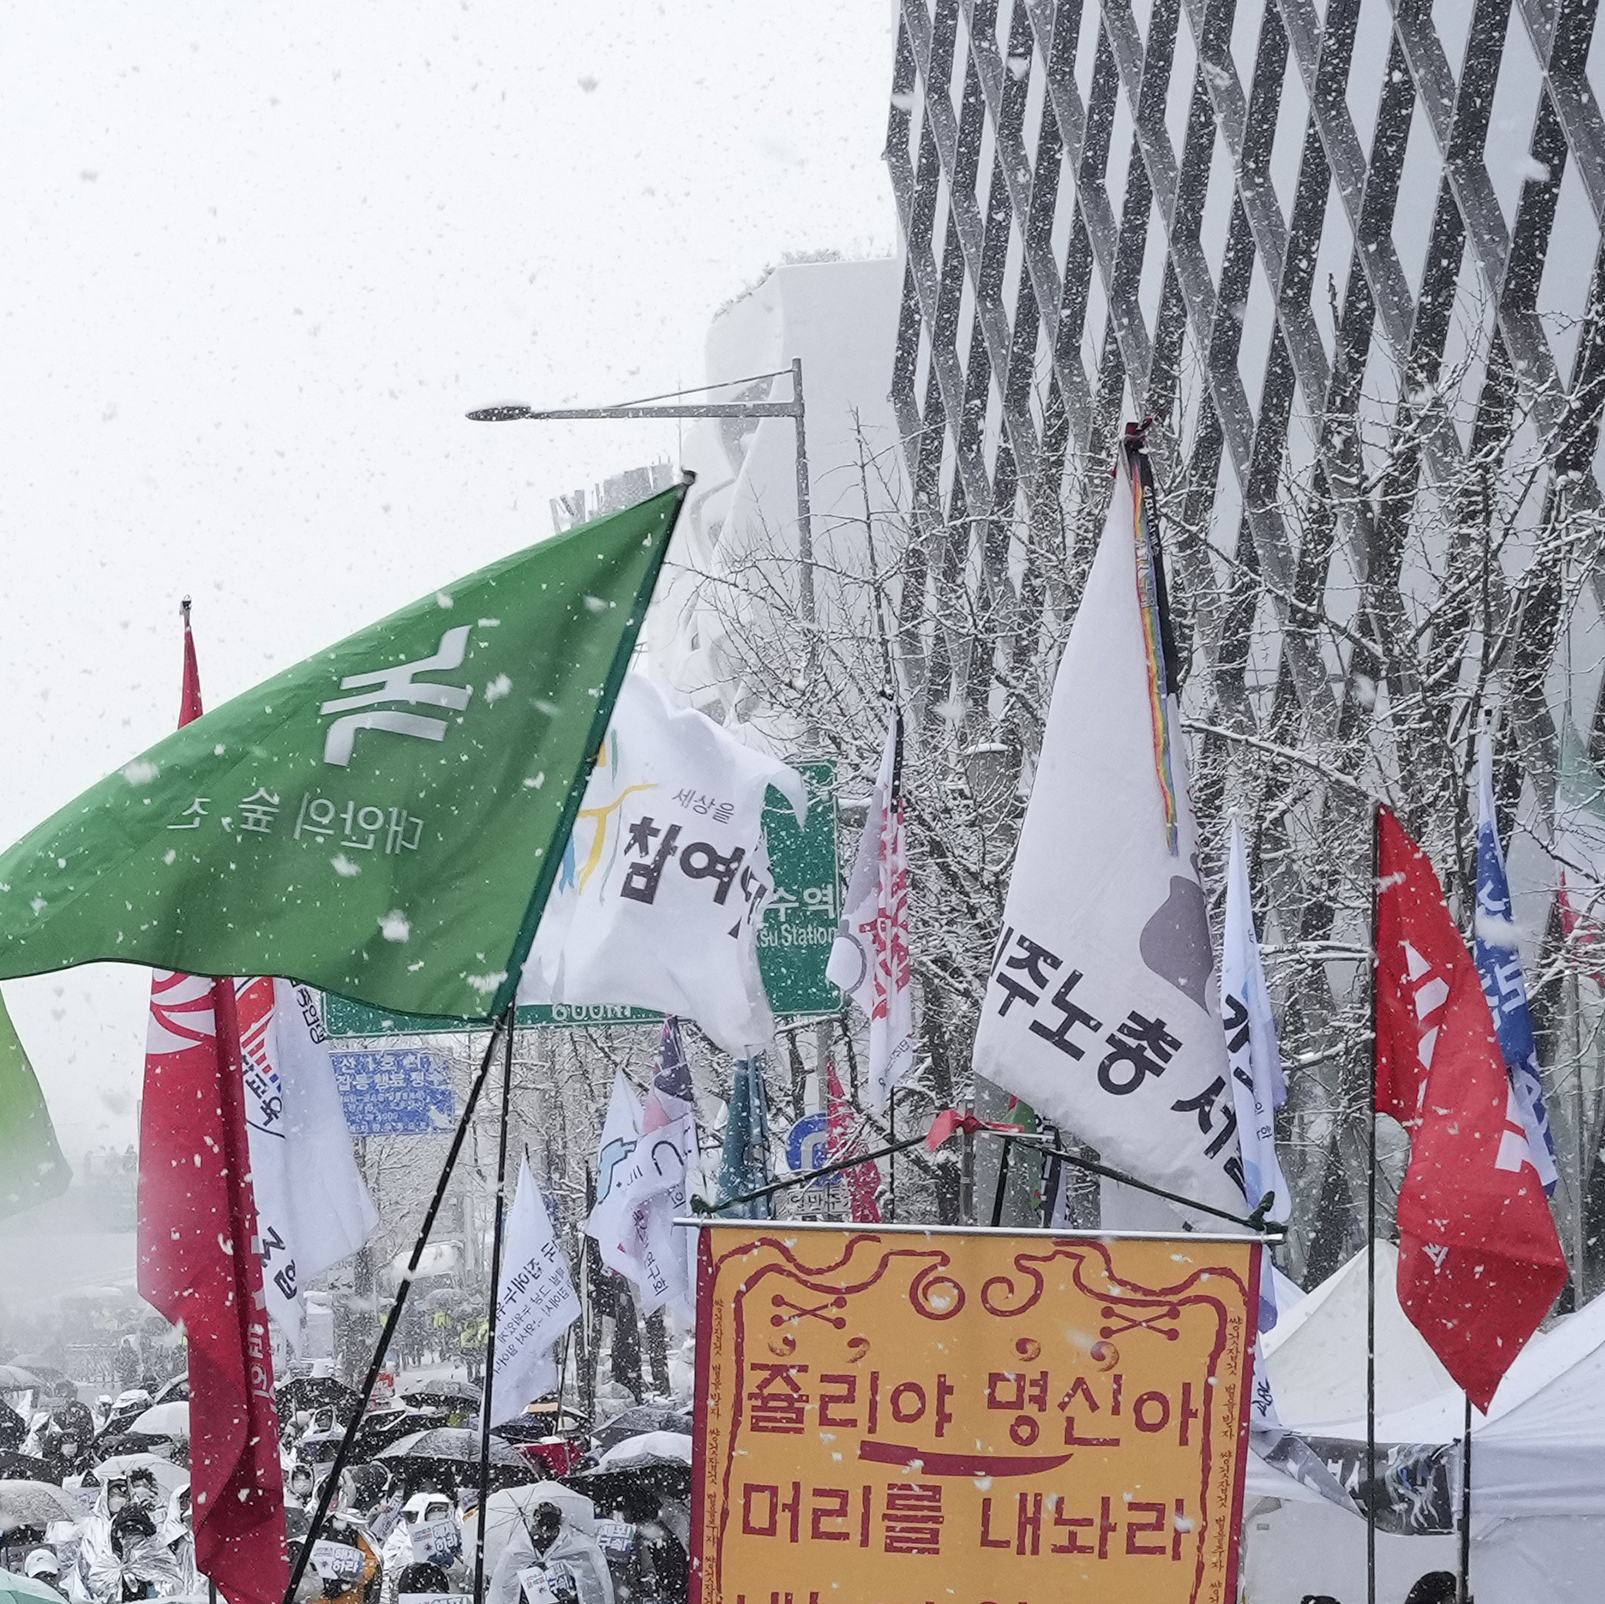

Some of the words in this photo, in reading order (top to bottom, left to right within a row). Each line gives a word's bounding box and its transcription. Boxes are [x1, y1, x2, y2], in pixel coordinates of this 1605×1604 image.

[671, 788, 736, 826] 세상을
[781, 923, 839, 947] Station
[989, 925, 1183, 1098] 주노총
[747, 1362, 954, 1438] 쥴리야
[987, 1371, 1199, 1447] 명신아
[742, 1480, 945, 1555] 머리를
[980, 1492, 1187, 1562] 내놔라
